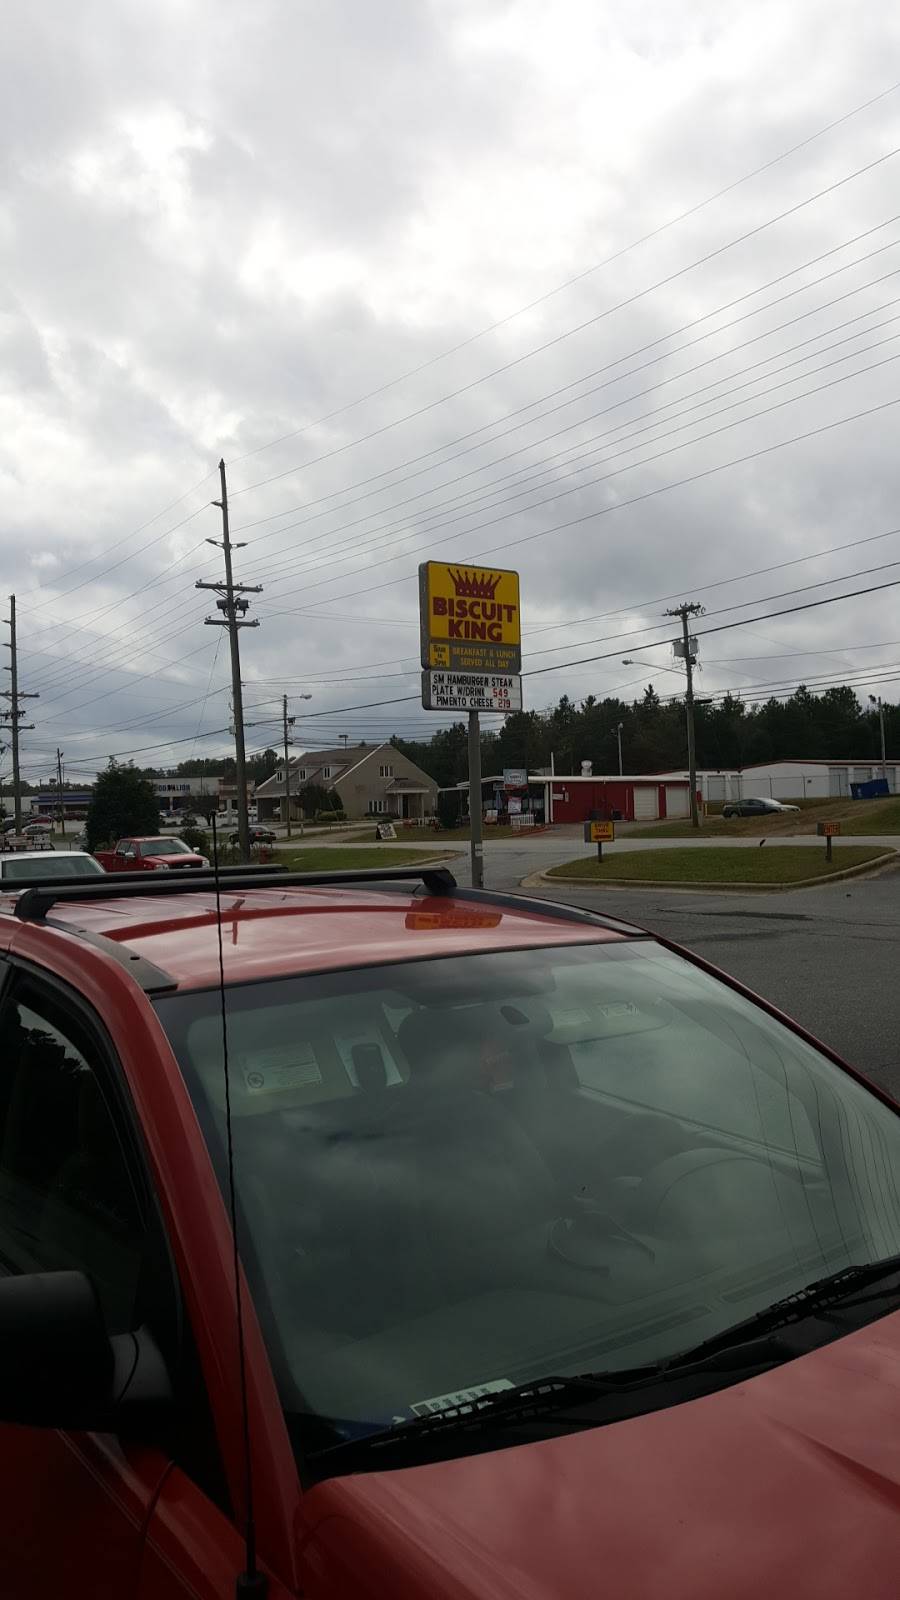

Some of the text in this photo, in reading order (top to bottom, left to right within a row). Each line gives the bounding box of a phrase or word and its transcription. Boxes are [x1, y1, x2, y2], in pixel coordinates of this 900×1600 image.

[432, 596, 517, 623] BISCUIT
[448, 618, 502, 642] KING
[433, 674, 513, 688] SM HAMBURGER STEAK
[432, 684, 453, 696] PLATE
[456, 686, 486, 697] W/DRINK
[436, 695, 467, 707] PIMENTO
[469, 697, 494, 707] CHEESE
